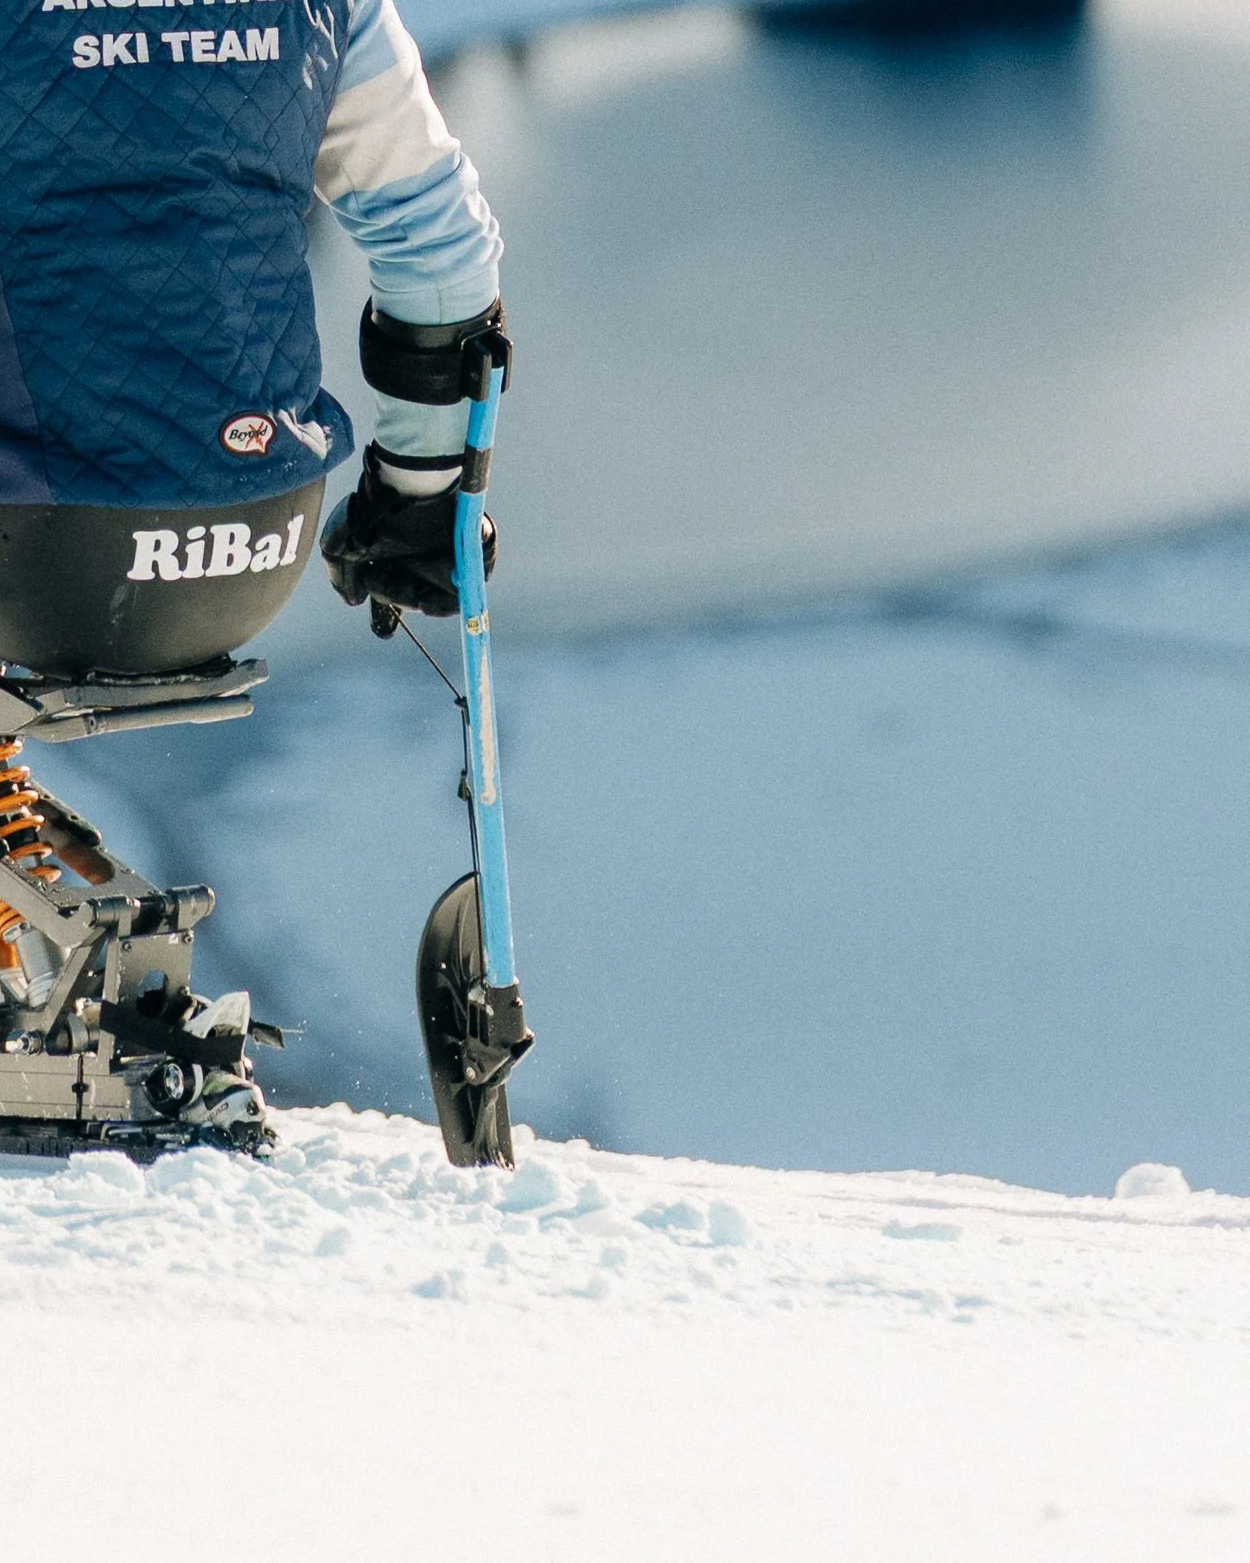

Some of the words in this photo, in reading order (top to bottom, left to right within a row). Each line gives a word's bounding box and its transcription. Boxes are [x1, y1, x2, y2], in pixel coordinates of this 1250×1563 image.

[72, 32, 149, 69] SKI
[161, 27, 280, 64] TEAM
[126, 513, 305, 581] RiBal
